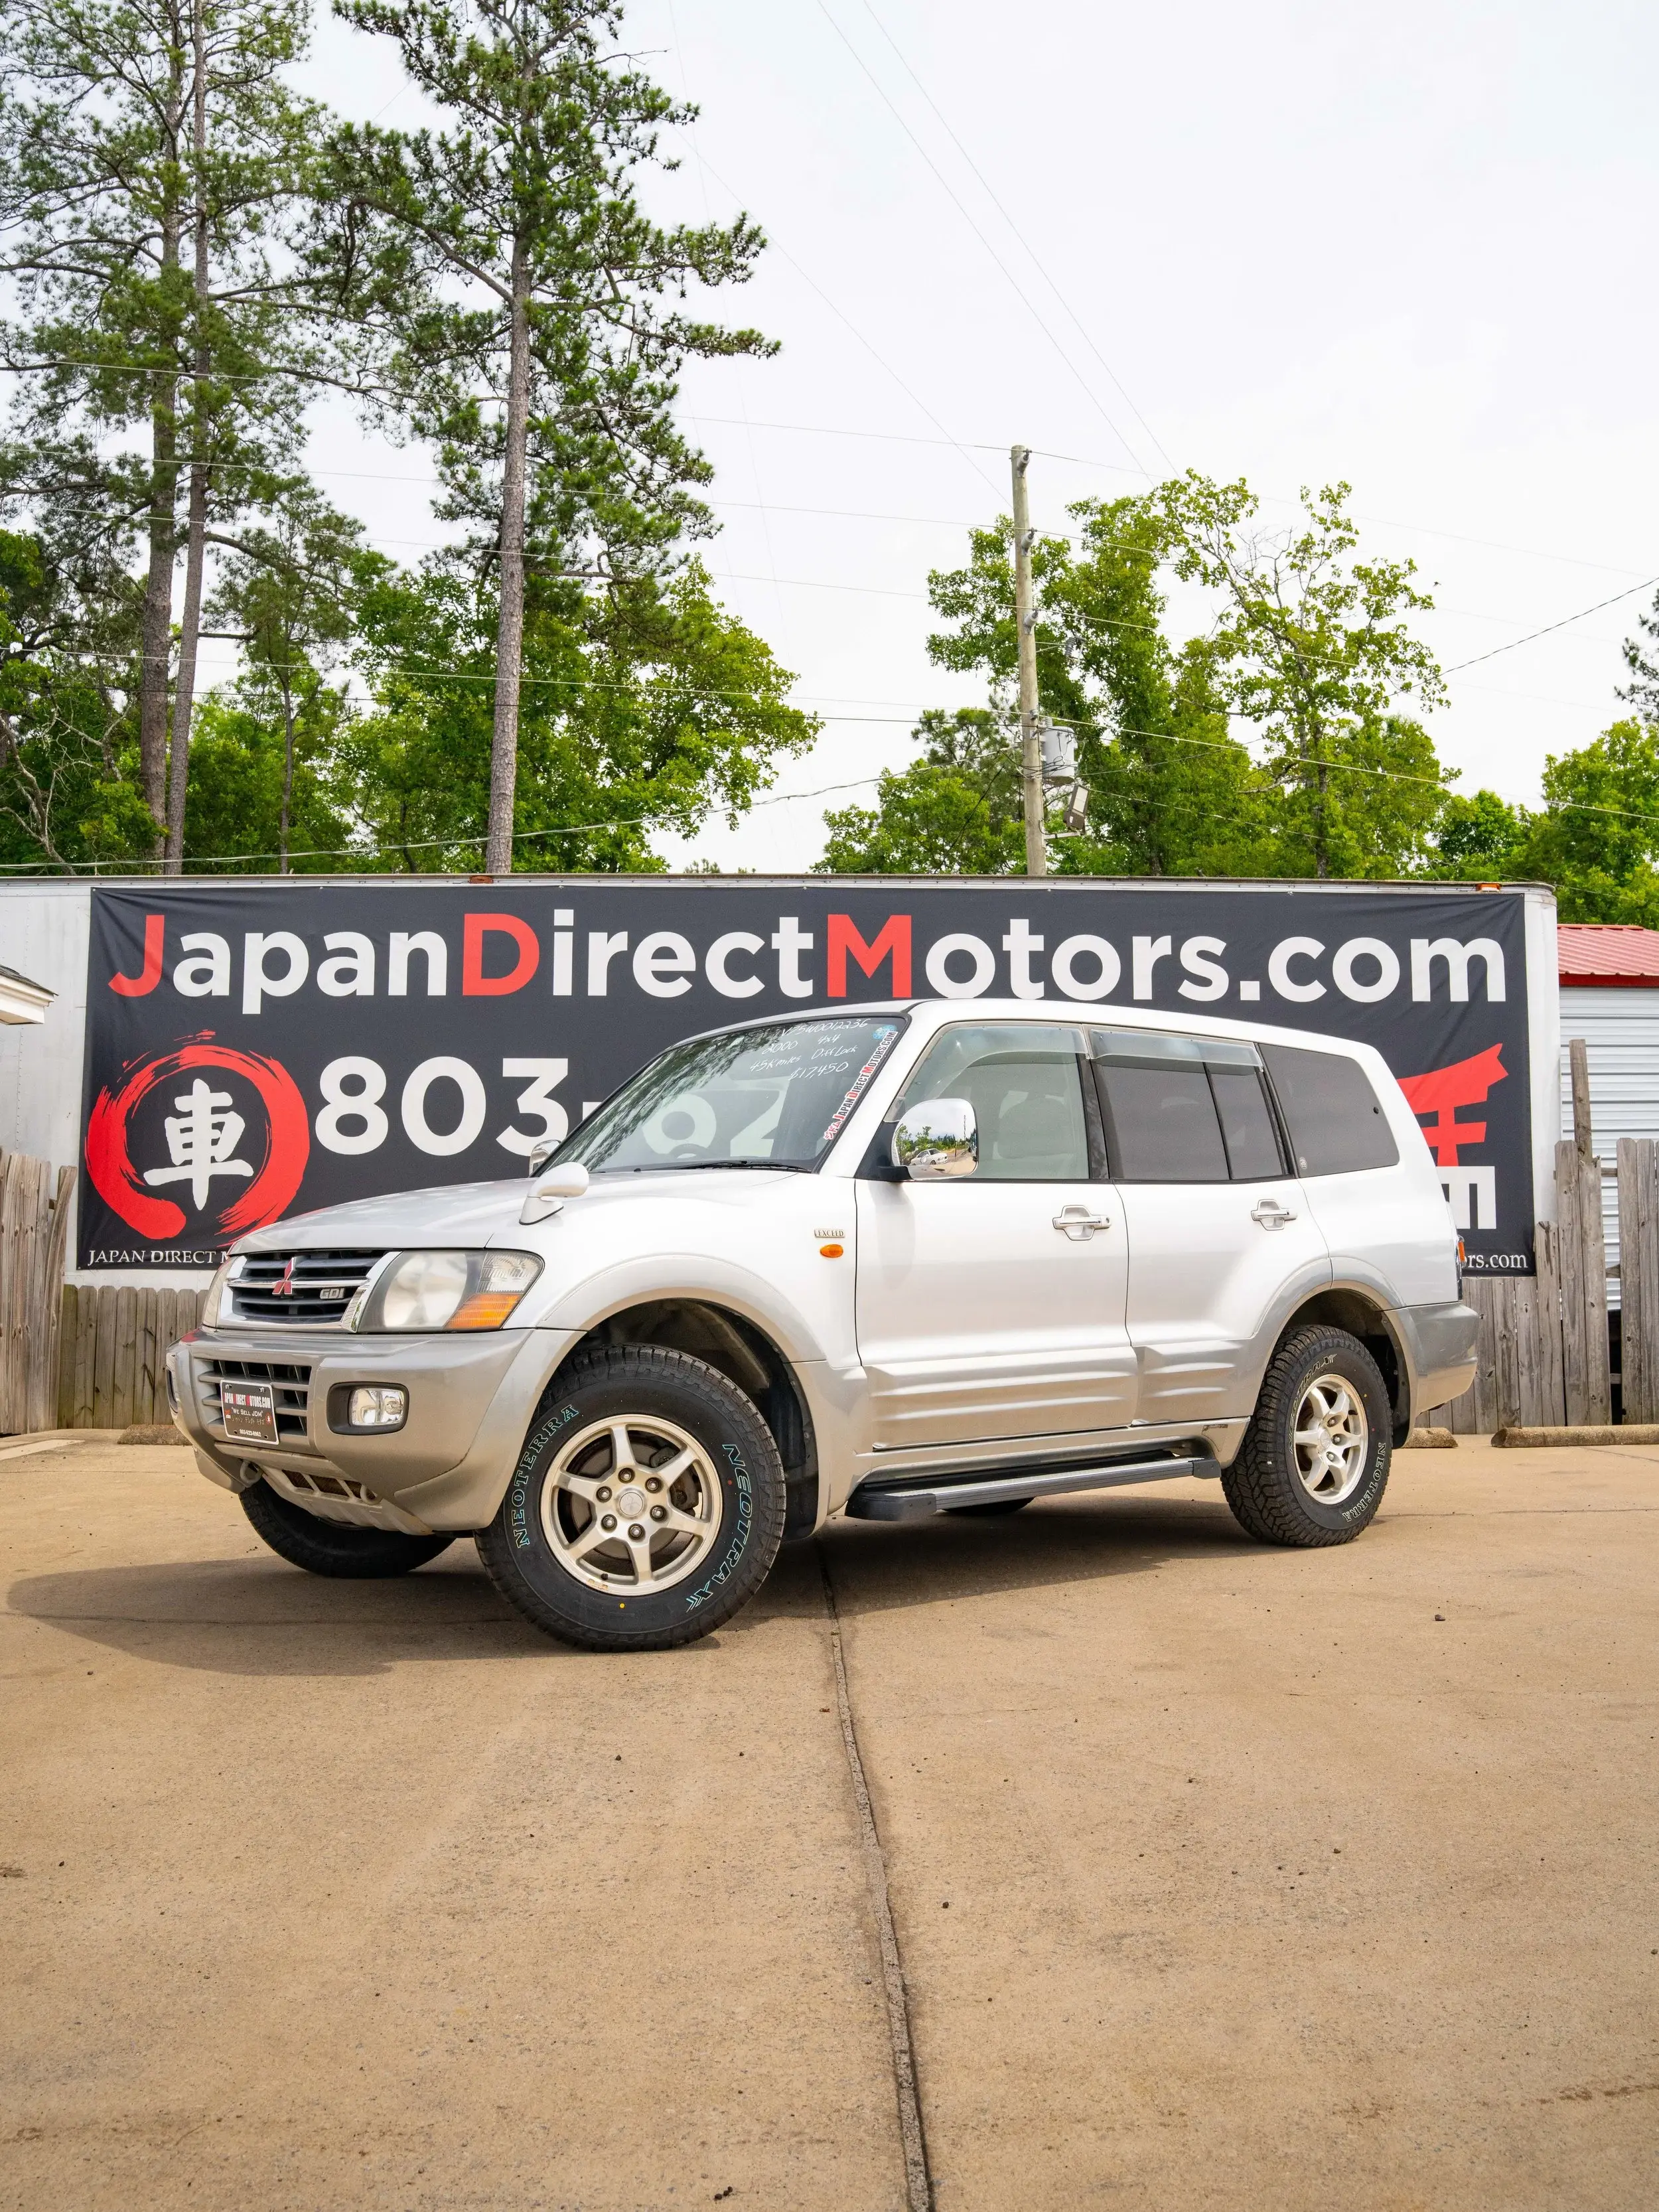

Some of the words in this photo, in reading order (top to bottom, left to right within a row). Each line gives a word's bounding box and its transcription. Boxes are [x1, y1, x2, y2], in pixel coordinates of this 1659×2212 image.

[108, 909, 1506, 1015] JapanDirectMotors.com
[762, 1040, 798, 1055] 2000
[818, 1033, 841, 1045] 4x4
[788, 1061, 849, 1081] $17,450
[144, 1078, 253, 1211] 車
[88, 1250, 145, 1266] JAPAN
[150, 1250, 216, 1264] DIRECT
[1465, 1254, 1528, 1268] rs.com
[319, 1288, 345, 1299] GDI
[511, 1404, 579, 1548] NEOTERRA
[1342, 1442, 1386, 1522] NEOTERRA
[685, 1444, 753, 1613] NEOTRAX
